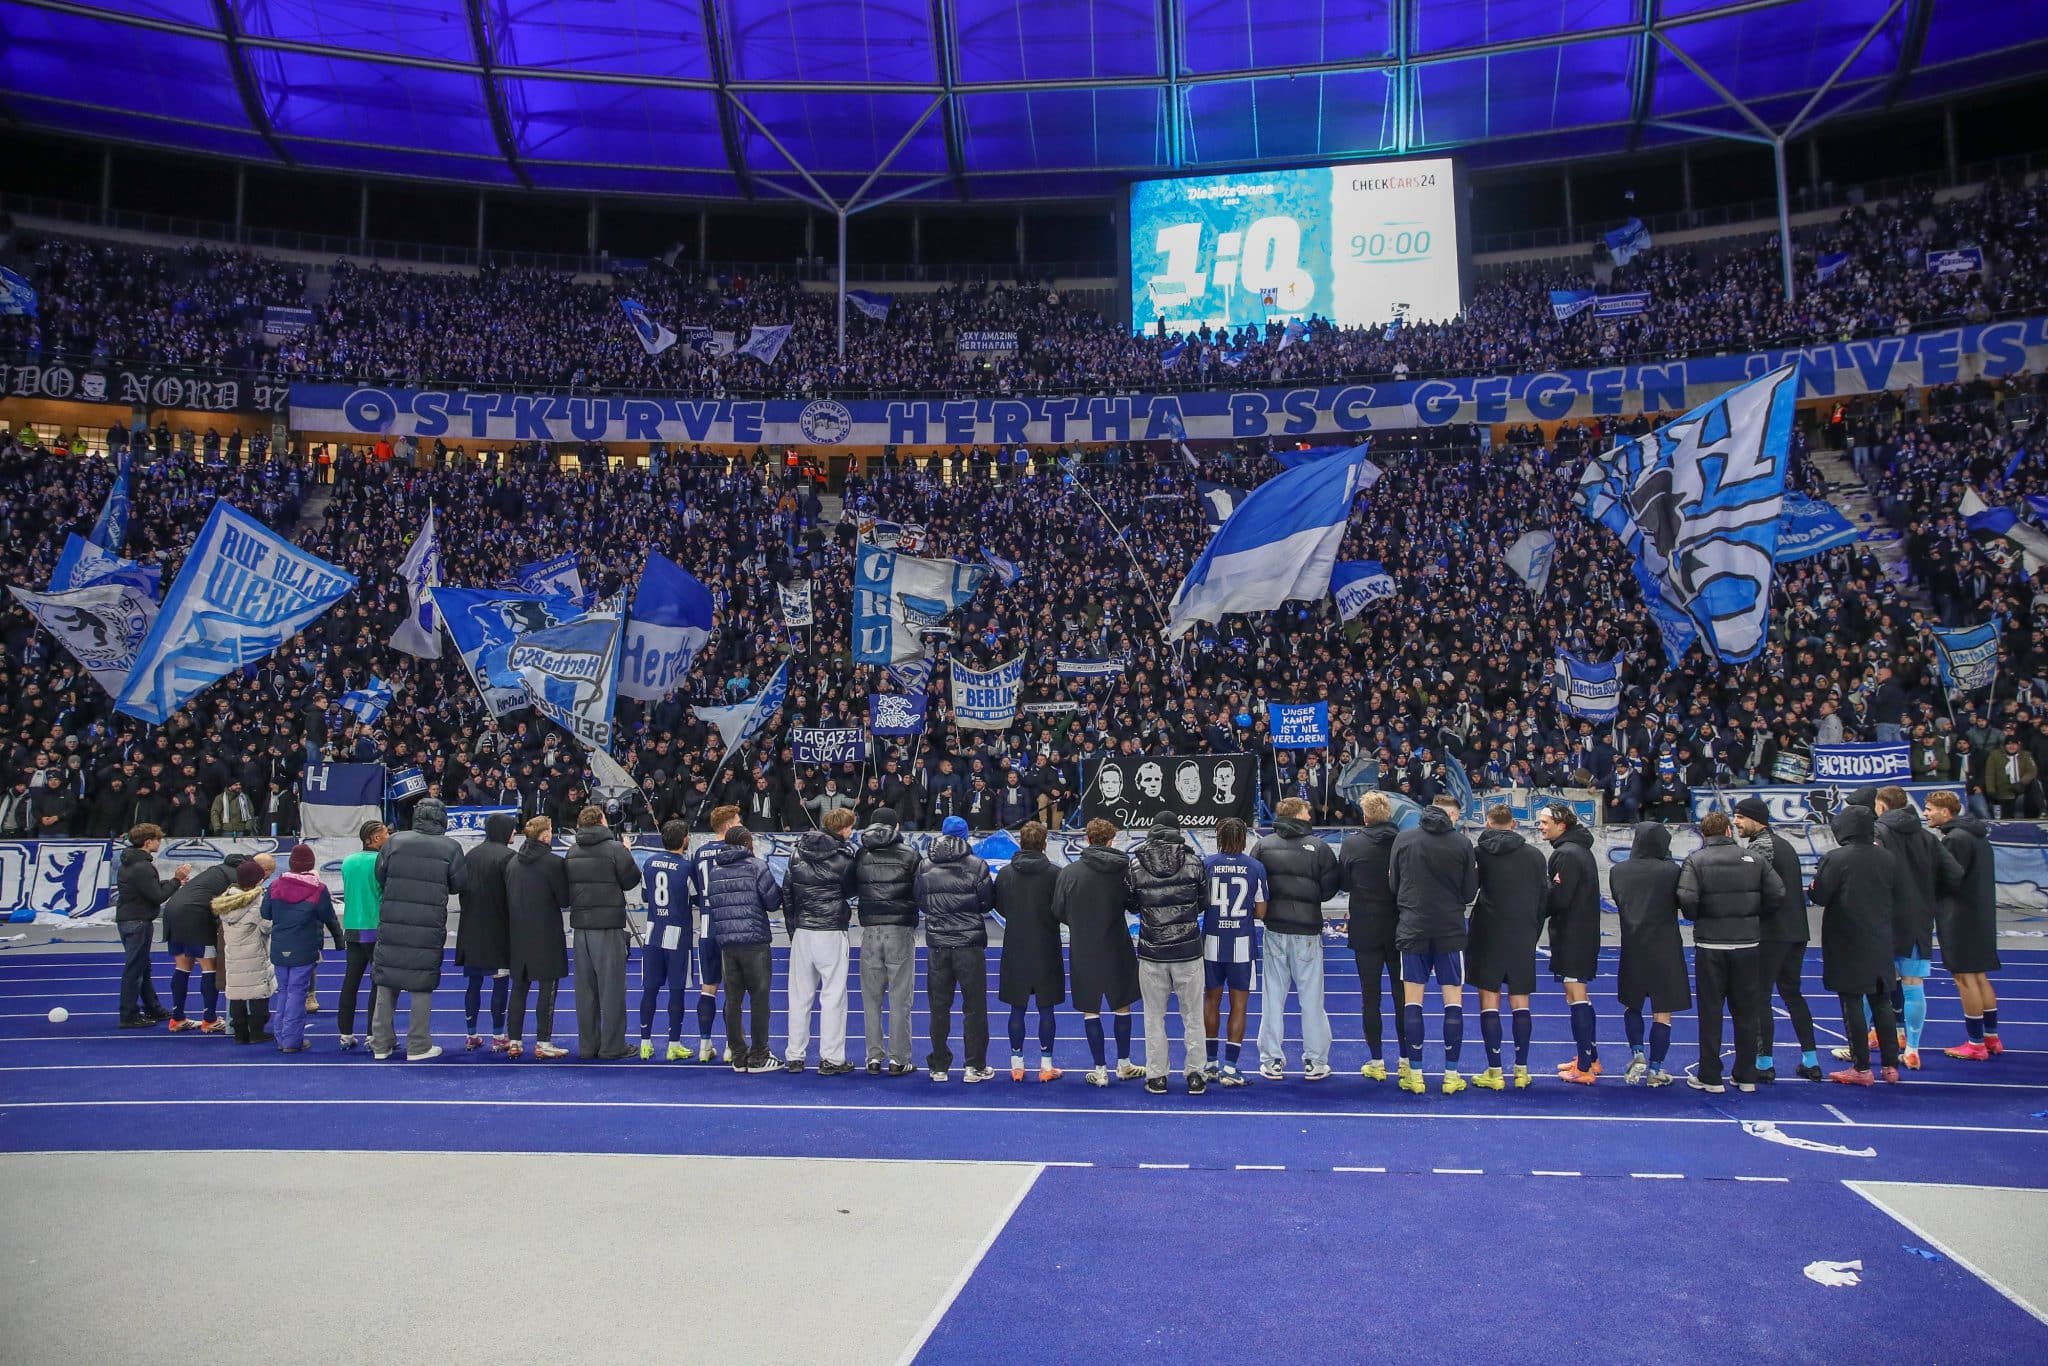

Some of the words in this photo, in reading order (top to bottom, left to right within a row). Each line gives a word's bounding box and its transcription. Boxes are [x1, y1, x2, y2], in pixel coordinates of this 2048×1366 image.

[1351, 231, 1431, 257] 90:00
[981, 331, 1018, 341] AMAZING
[1411, 361, 1687, 425] GEGEN
[1744, 322, 2048, 399] INVES
[119, 371, 240, 410] NORD
[343, 388, 767, 441] OSTKURVE
[886, 395, 1185, 444] HERTHA
[1228, 386, 1377, 437] BSC
[805, 403, 846, 418] OSTKURVE
[1777, 523, 1836, 546] ANDAU
[219, 522, 270, 573] AUF
[1339, 587, 1372, 616] ertha
[953, 662, 1001, 687] GRUPPA
[1281, 707, 1316, 716] UNSER
[1283, 716, 1314, 724] KAMPF
[793, 729, 863, 744] RAGAZZI
[1280, 725, 1297, 734] IST
[1301, 724, 1319, 733] NIE
[800, 746, 855, 761] CURVA
[1115, 808, 1218, 827] Unvessen
[651, 860, 668, 868] HERTHA
[668, 862, 679, 870] BSC
[1214, 865, 1236, 874] HERTHA
[1237, 866, 1248, 874] BSC
[654, 871, 669, 907] 8
[1210, 876, 1249, 917] 42
